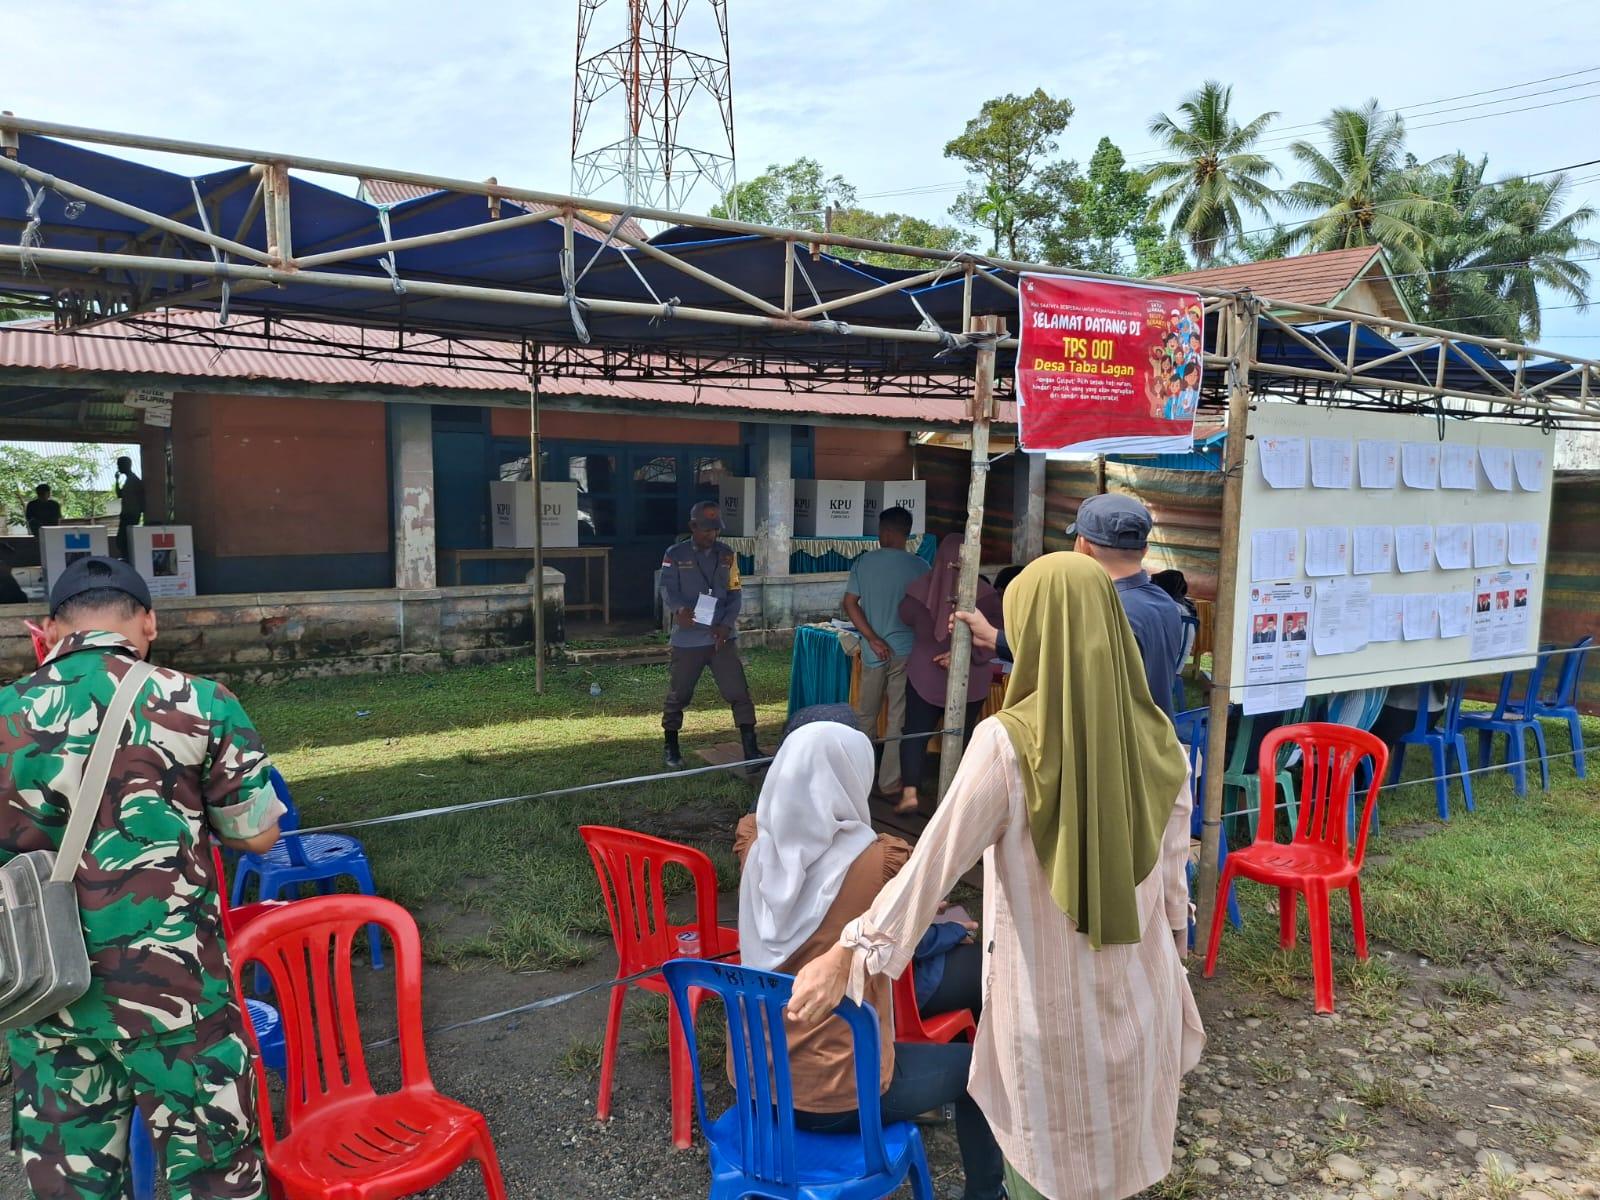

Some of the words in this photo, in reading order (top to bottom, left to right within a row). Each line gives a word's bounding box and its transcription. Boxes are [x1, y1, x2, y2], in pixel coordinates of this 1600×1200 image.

[1033, 311, 1083, 331] SELAMAT
[1085, 316, 1127, 335] DATANG
[1129, 321, 1141, 336] DI
[1062, 336, 1087, 358] TPS
[1091, 339, 1113, 360] 001
[1034, 358, 1065, 372] Desa
[1069, 360, 1098, 374] Taba
[1101, 362, 1134, 377] Lagan
[724, 496, 739, 508] KPU
[794, 498, 811, 510] KPU
[829, 499, 852, 510] KPU
[863, 499, 877, 509] KPU
[497, 504, 511, 516] KPU
[542, 504, 561, 516] PU
